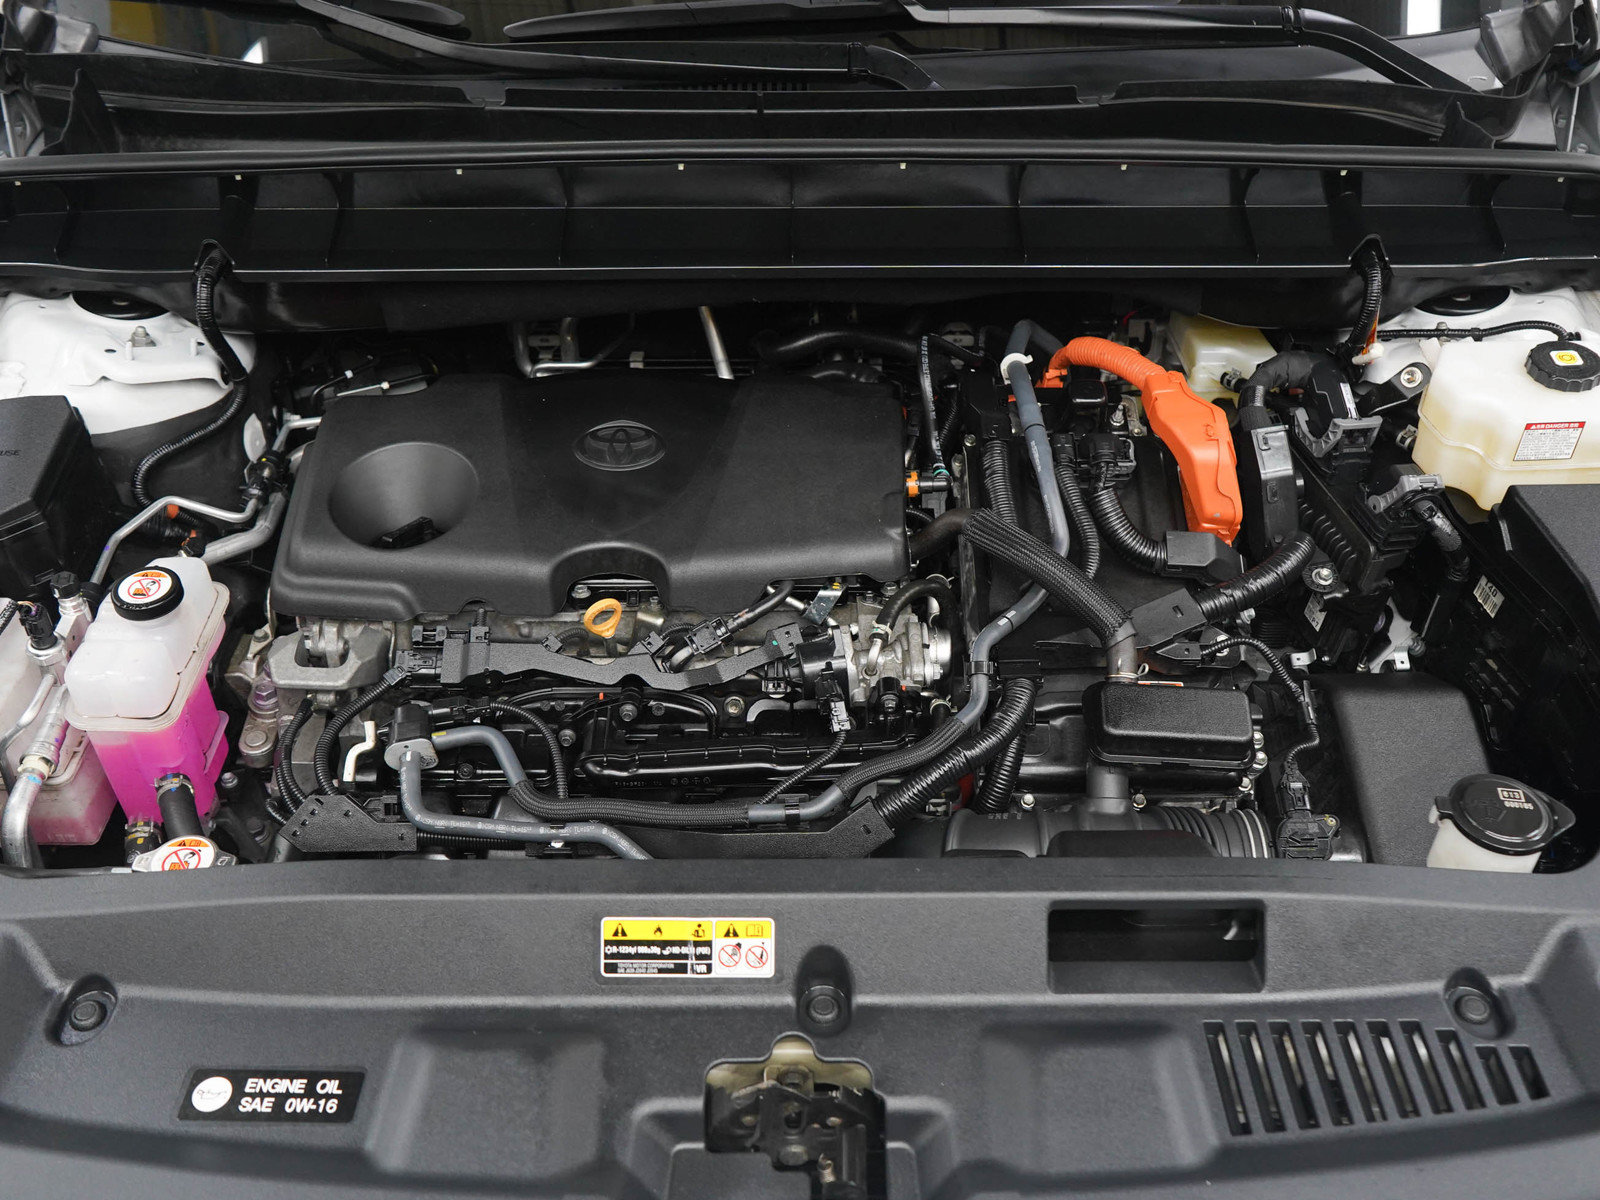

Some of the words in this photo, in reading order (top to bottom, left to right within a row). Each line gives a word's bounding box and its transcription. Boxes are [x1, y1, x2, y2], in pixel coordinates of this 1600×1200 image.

[245, 1079, 307, 1094] ENGINE
[316, 1079, 343, 1095] OIL
[238, 1097, 275, 1113] SAE
[284, 1098, 339, 1114] 0W-16
